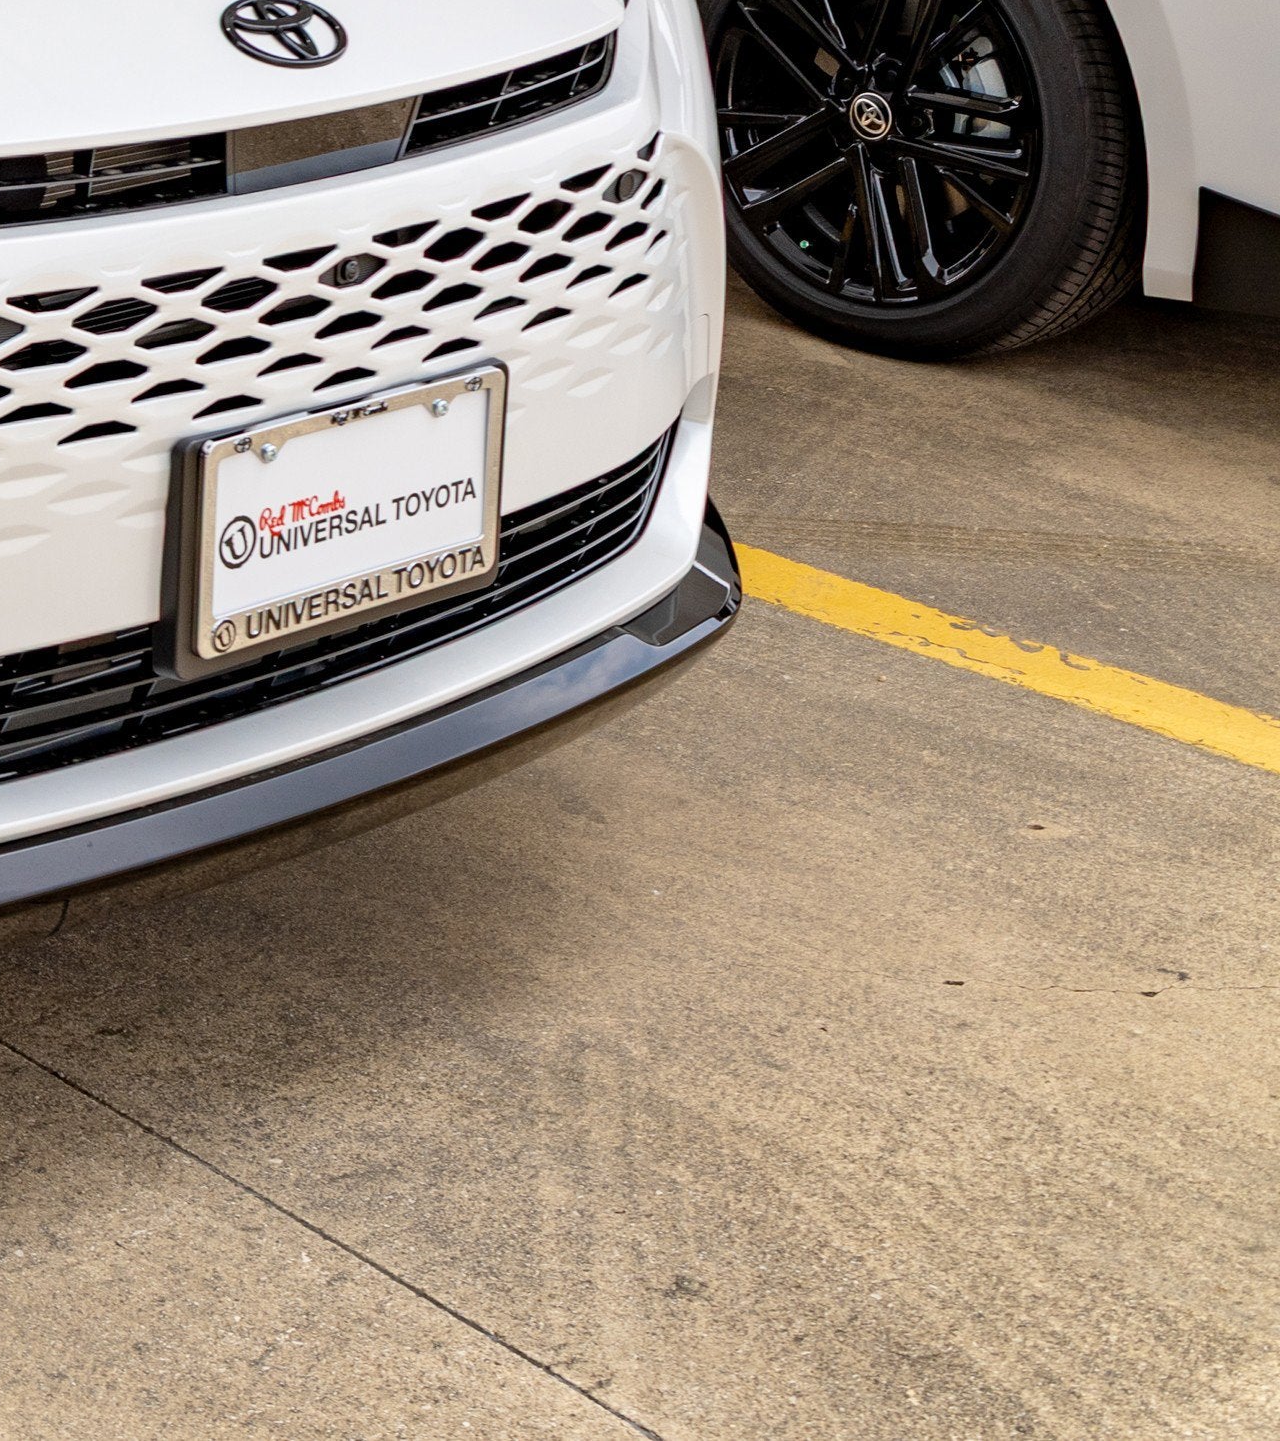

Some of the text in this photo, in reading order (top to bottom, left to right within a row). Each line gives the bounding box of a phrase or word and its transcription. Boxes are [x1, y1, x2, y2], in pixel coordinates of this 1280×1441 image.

[259, 505, 286, 537] Red
[260, 502, 387, 559] UNIVERSAL
[392, 477, 477, 521] TOYOTA
[245, 574, 389, 640] UNIVERSAL
[392, 543, 486, 593] TOYOTA
